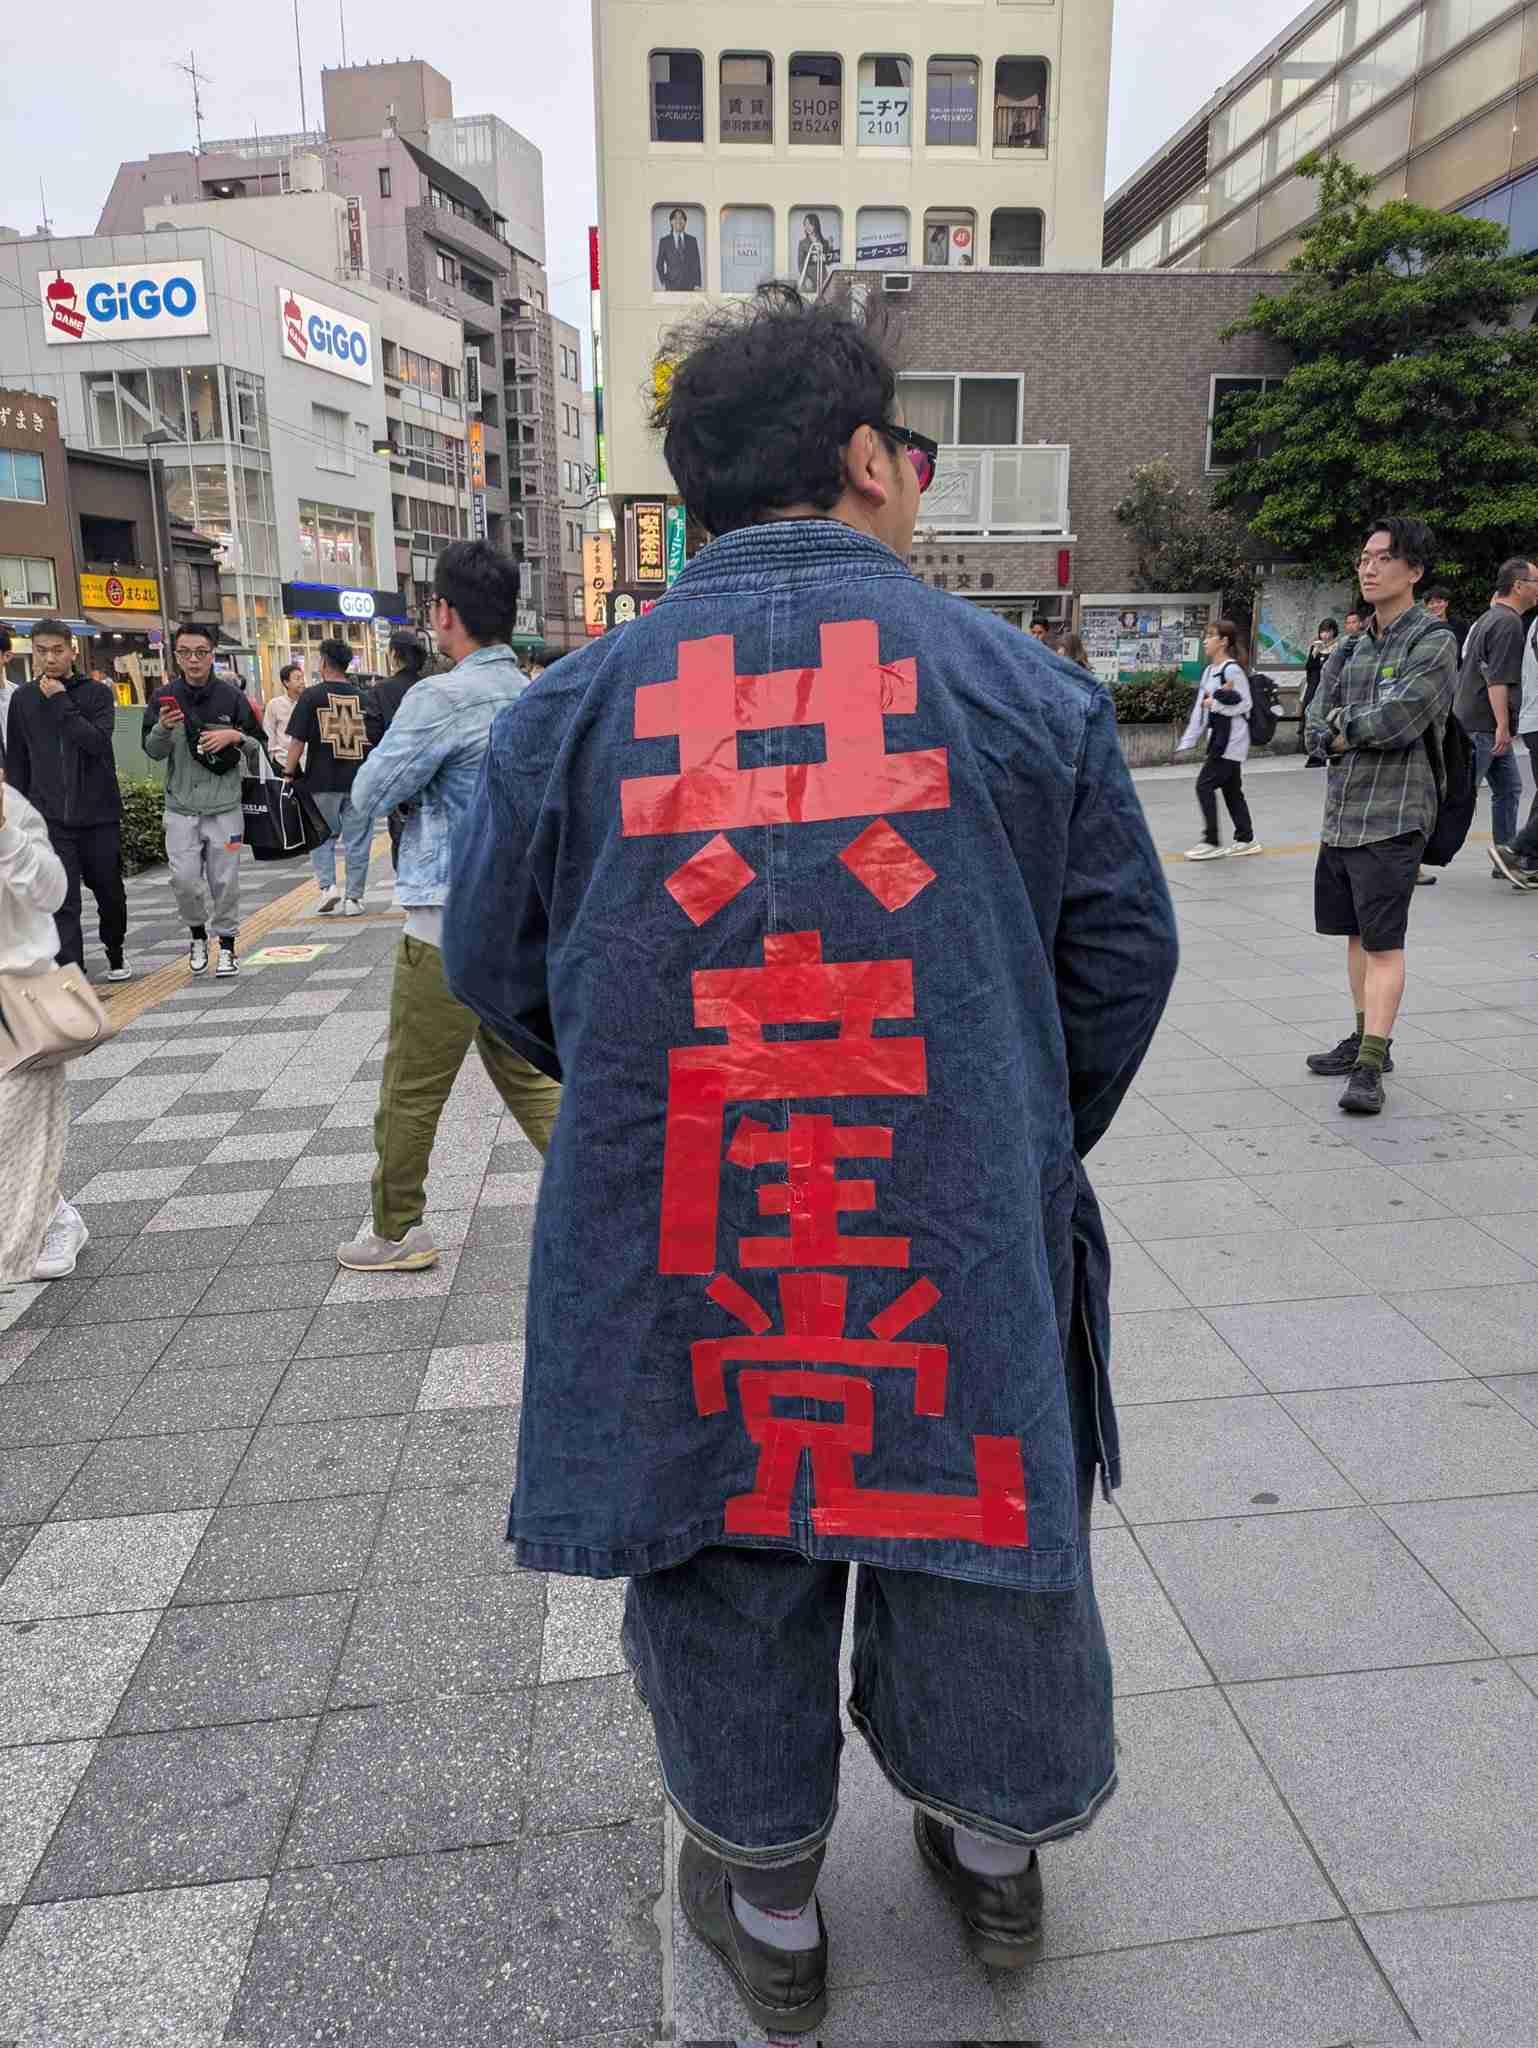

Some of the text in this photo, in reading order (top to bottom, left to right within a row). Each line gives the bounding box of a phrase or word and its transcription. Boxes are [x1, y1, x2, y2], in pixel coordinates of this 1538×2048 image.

[791, 99, 840, 116] SHOP
[858, 98, 909, 117] ニチワ
[867, 120, 900, 134] 2101
[54, 277, 197, 333] GAME GiGO
[308, 315, 367, 367] GiGO
[620, 619, 1028, 1547] 共産党
